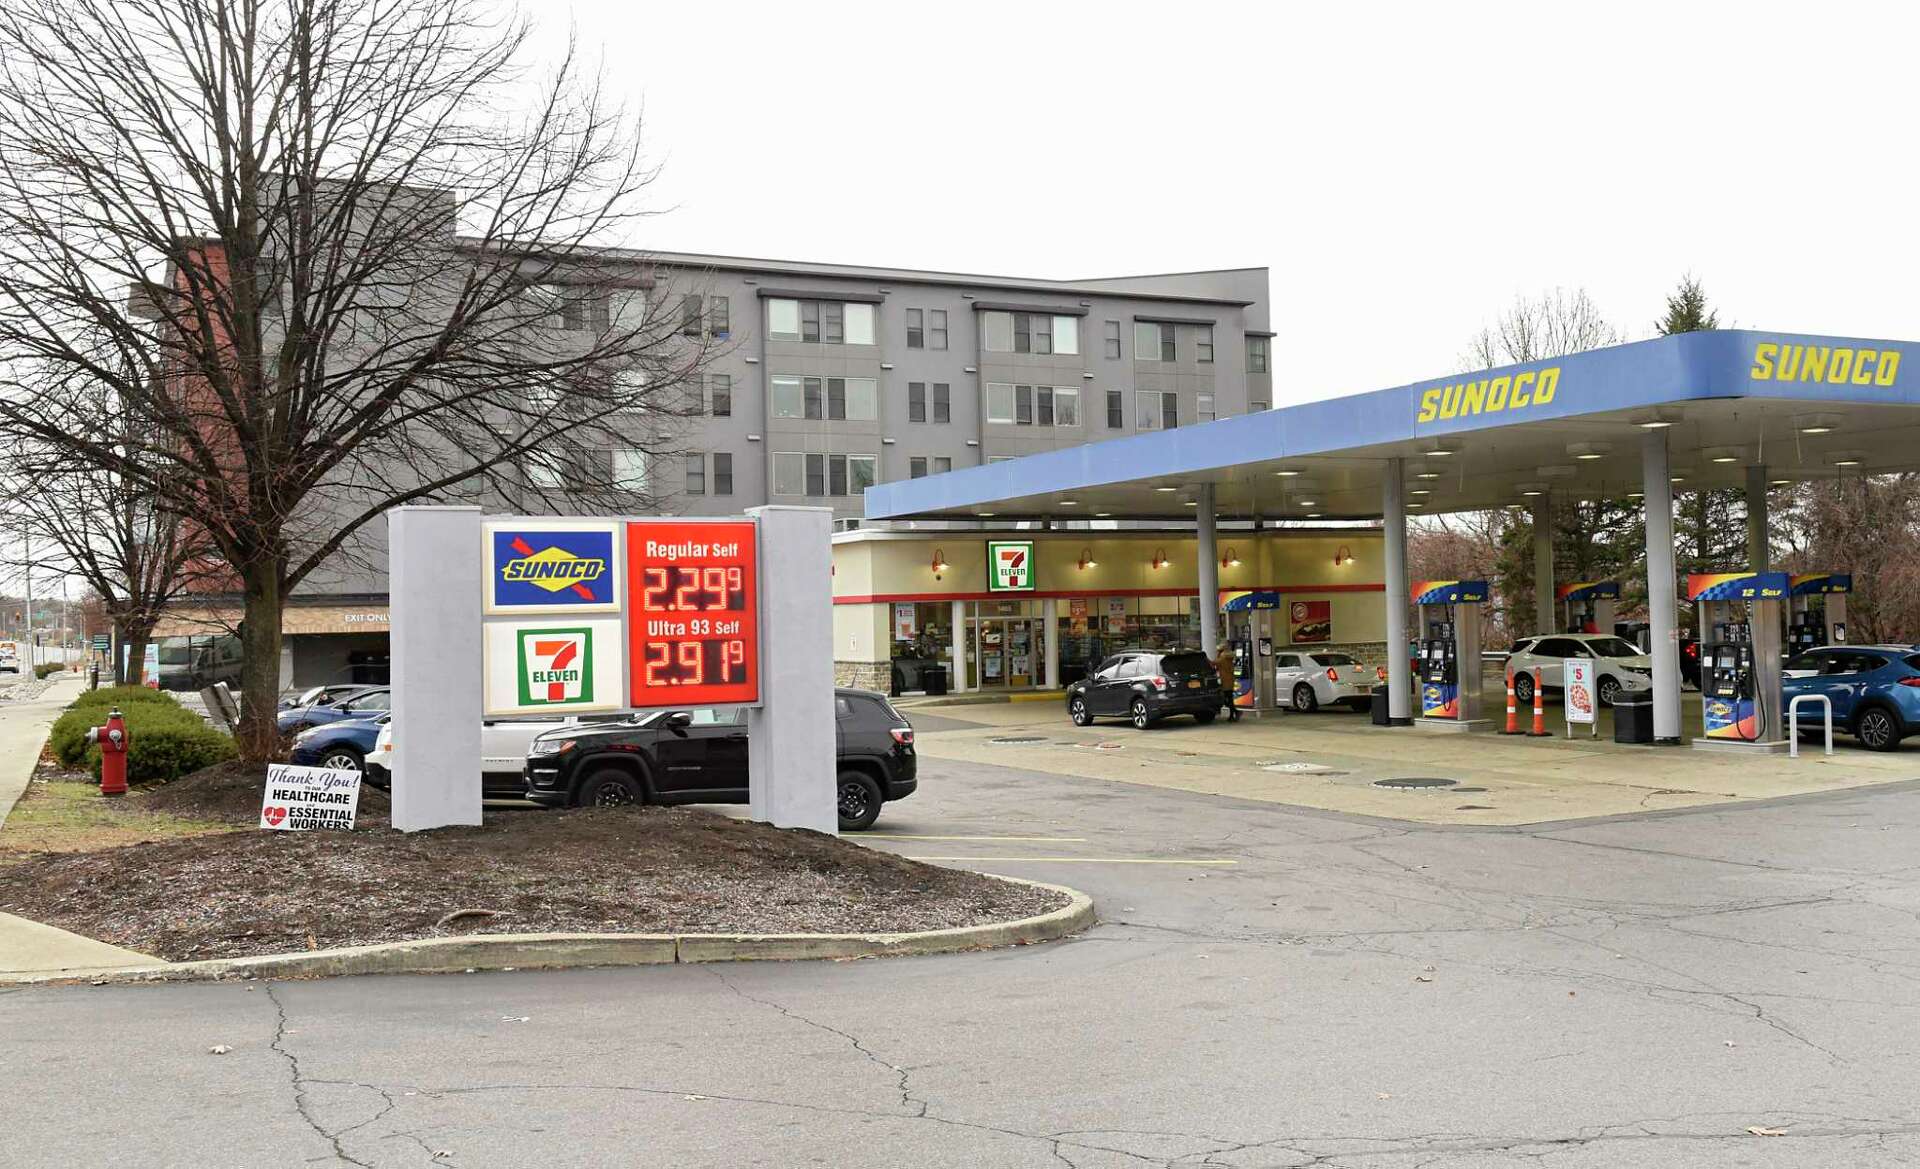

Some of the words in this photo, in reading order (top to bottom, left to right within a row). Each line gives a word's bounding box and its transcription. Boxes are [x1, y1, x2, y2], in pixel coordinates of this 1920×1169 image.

[1751, 343, 1901, 387] SUNOCO
[1418, 367, 1561, 423] SUNOCO
[646, 540, 709, 561] Regular
[712, 543, 738, 557] Self
[507, 561, 601, 579] SUNOCO
[1001, 551, 1025, 587] 7
[1742, 588, 1755, 597] 12
[345, 614, 364, 622] EXIT
[647, 620, 686, 636] Ultra
[691, 619, 710, 635] 93
[715, 620, 740, 634] Self
[535, 640, 577, 701] 7
[269, 767, 314, 785] Thank
[319, 772, 360, 791] You!
[272, 789, 351, 804] HEALTHCARE
[289, 807, 353, 821] ESSENTIAL
[290, 818, 350, 830] WORKERS
